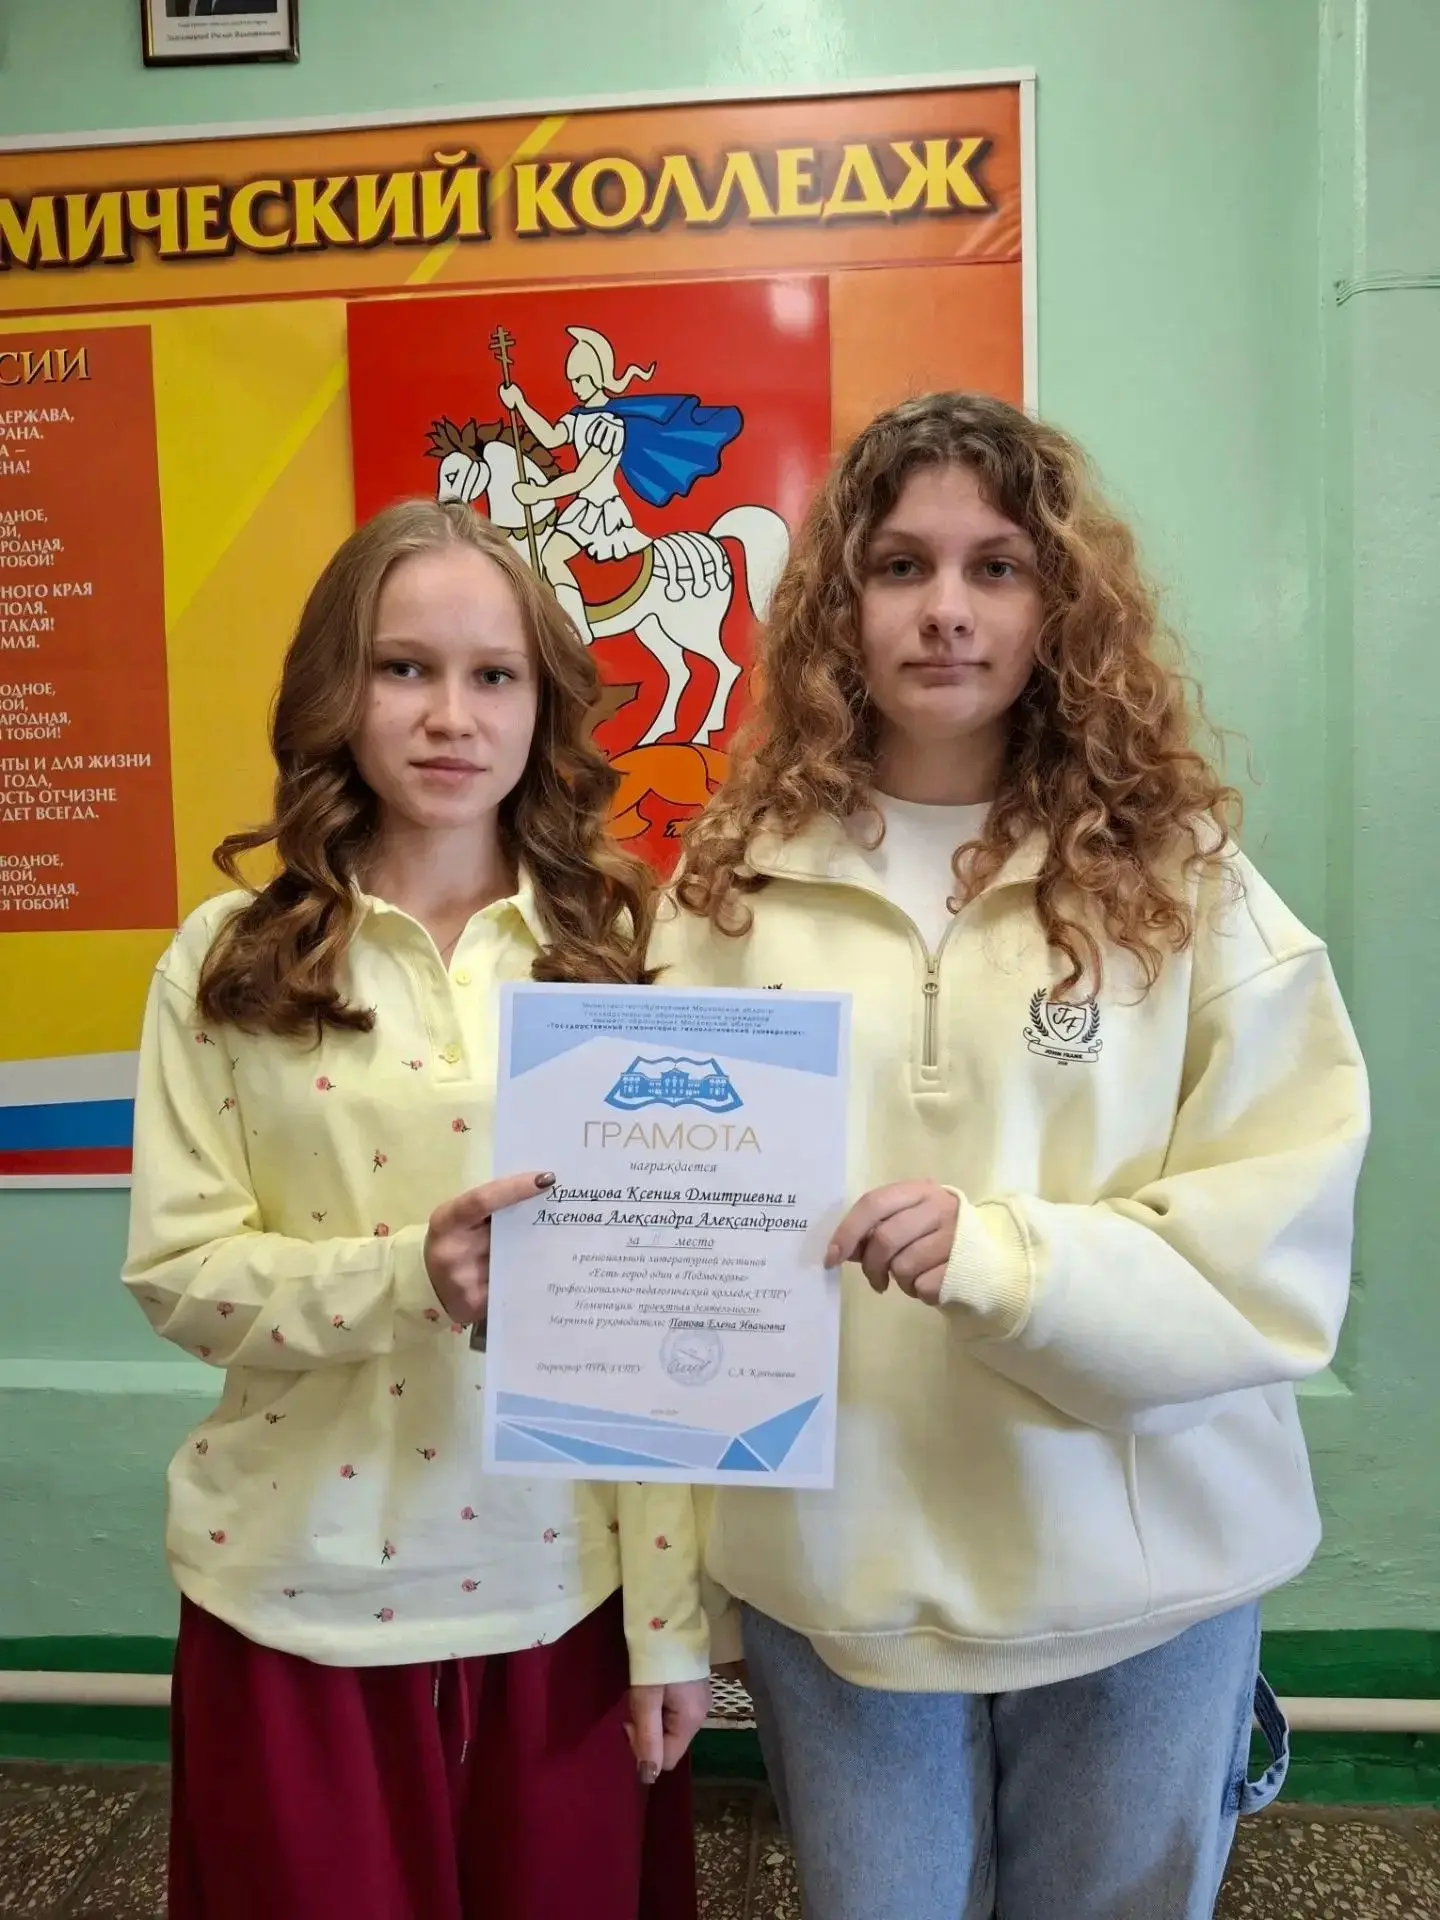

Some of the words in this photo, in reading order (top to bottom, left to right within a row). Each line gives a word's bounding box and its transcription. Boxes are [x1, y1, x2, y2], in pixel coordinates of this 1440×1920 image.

[0, 149, 483, 263] МИЧЕСКИЙ
[514, 136, 991, 232] КОЛЛЕДЖ
[0, 347, 91, 385] СИИ
[0, 508, 48, 525] ДНОЕ,
[0, 538, 65, 552] РОДНАЯ,
[0, 550, 54, 567] ТОБОЙ!
[1, 584, 48, 599] НОГО
[53, 582, 92, 597] КРАЯ
[0, 600, 48, 616] ПОЛЯ.
[0, 617, 54, 632] ТАКАЯ!
[1, 635, 40, 649] МЛЯ.
[0, 682, 56, 698] ОДНОЕ,
[0, 697, 28, 712] ОЙ,
[0, 711, 71, 726] АРОДНАЯ,
[6, 723, 61, 740] ТОБОЙ!
[34, 757, 46, 770] И
[51, 756, 83, 771] ДЛЯ
[88, 753, 151, 769] ЖИЗНИ
[4, 773, 52, 788] ГОДА,
[39, 788, 117, 803] ОТЧИЗНЕ
[0, 807, 31, 821] ДЕТ
[36, 805, 99, 820] ВСЕГДА.
[0, 865, 37, 883] ВОЙ,
[14, 894, 70, 911] ТОБОЙ!
[583, 1120, 762, 1153] ГРАМОТА
[630, 1159, 718, 1175] награждается
[547, 1184, 622, 1202] Храмцова
[627, 1186, 681, 1202] Ксения
[685, 1187, 783, 1206] Дмитриевна
[787, 1193, 797, 1204] и
[532, 1208, 603, 1226] Аксенова
[604, 1209, 693, 1229] Александра
[694, 1211, 808, 1232] Александровна
[674, 1236, 714, 1248] место
[668, 1317, 705, 1329] Попова
[707, 1318, 737, 1330] Елена
[738, 1319, 786, 1332] Ивановна
